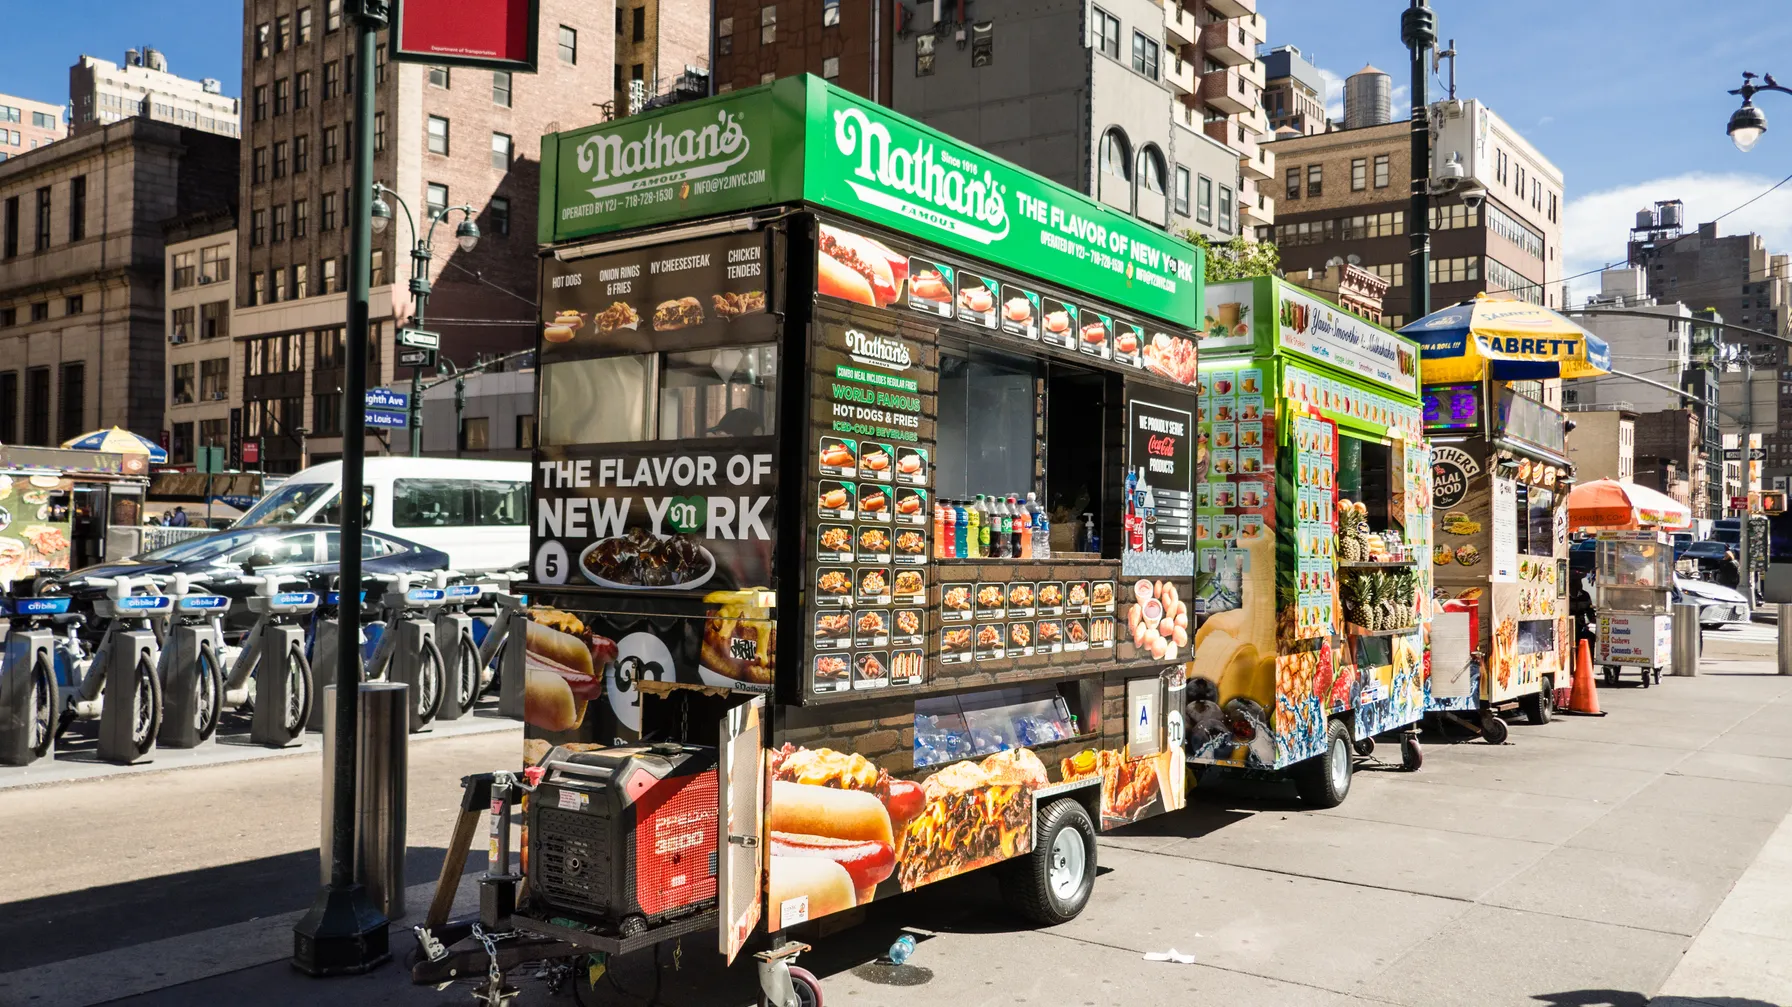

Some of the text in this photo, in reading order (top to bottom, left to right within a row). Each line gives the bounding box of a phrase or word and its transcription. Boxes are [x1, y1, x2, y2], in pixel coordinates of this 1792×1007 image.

[464, 48, 497, 56] Transportation
[577, 110, 745, 182] Nathan's
[834, 108, 1006, 226] Nathan's
[941, 150, 978, 175] Since 1916
[631, 172, 687, 189] FAMOUS
[562, 204, 594, 220] OPERATED
[594, 202, 604, 214] BY
[605, 198, 617, 212] Y2J
[694, 169, 766, 195] INFO@Y2JNYC.COM
[901, 203, 956, 231] FAMOUS
[1016, 190, 1048, 225] THE
[1050, 206, 1107, 248] FLAVOR
[1109, 231, 1129, 255] OF
[1130, 239, 1160, 269] NEW
[1040, 230, 1068, 253] OPERATED
[651, 254, 710, 275] NY CHEESESTEAK
[728, 246, 761, 264] CHICKEN
[599, 265, 640, 282] ONION RINGS
[727, 262, 761, 280] TENDERS
[552, 274, 582, 289] HOT DOGS
[613, 281, 631, 295] FRIES
[1436, 342, 1451, 350] ROLL
[1478, 336, 1578, 355] SABRETT
[838, 367, 917, 391] COMBO MEAL INCLUDES REGULAR FRIES
[366, 393, 404, 405] ighth Ave
[832, 384, 921, 412] WORLD FAMOUS
[374, 414, 391, 424] Louis
[833, 403, 855, 418] HOT
[857, 408, 883, 422] DOGS
[893, 413, 919, 428] FRIES
[1139, 415, 1148, 430] WE
[1148, 416, 1169, 434] PROUDLY
[876, 427, 918, 442] BEVERAGES
[540, 454, 772, 488] THE FLAVOR OF
[1150, 457, 1174, 475] PRODUCTS
[1433, 472, 1461, 487] ALAL
[537, 497, 632, 538] NEW
[545, 554, 558, 578] 5
[1611, 617, 1629, 625] Peanuts
[1611, 627, 1631, 635] Almonds
[1140, 705, 1148, 726] A
